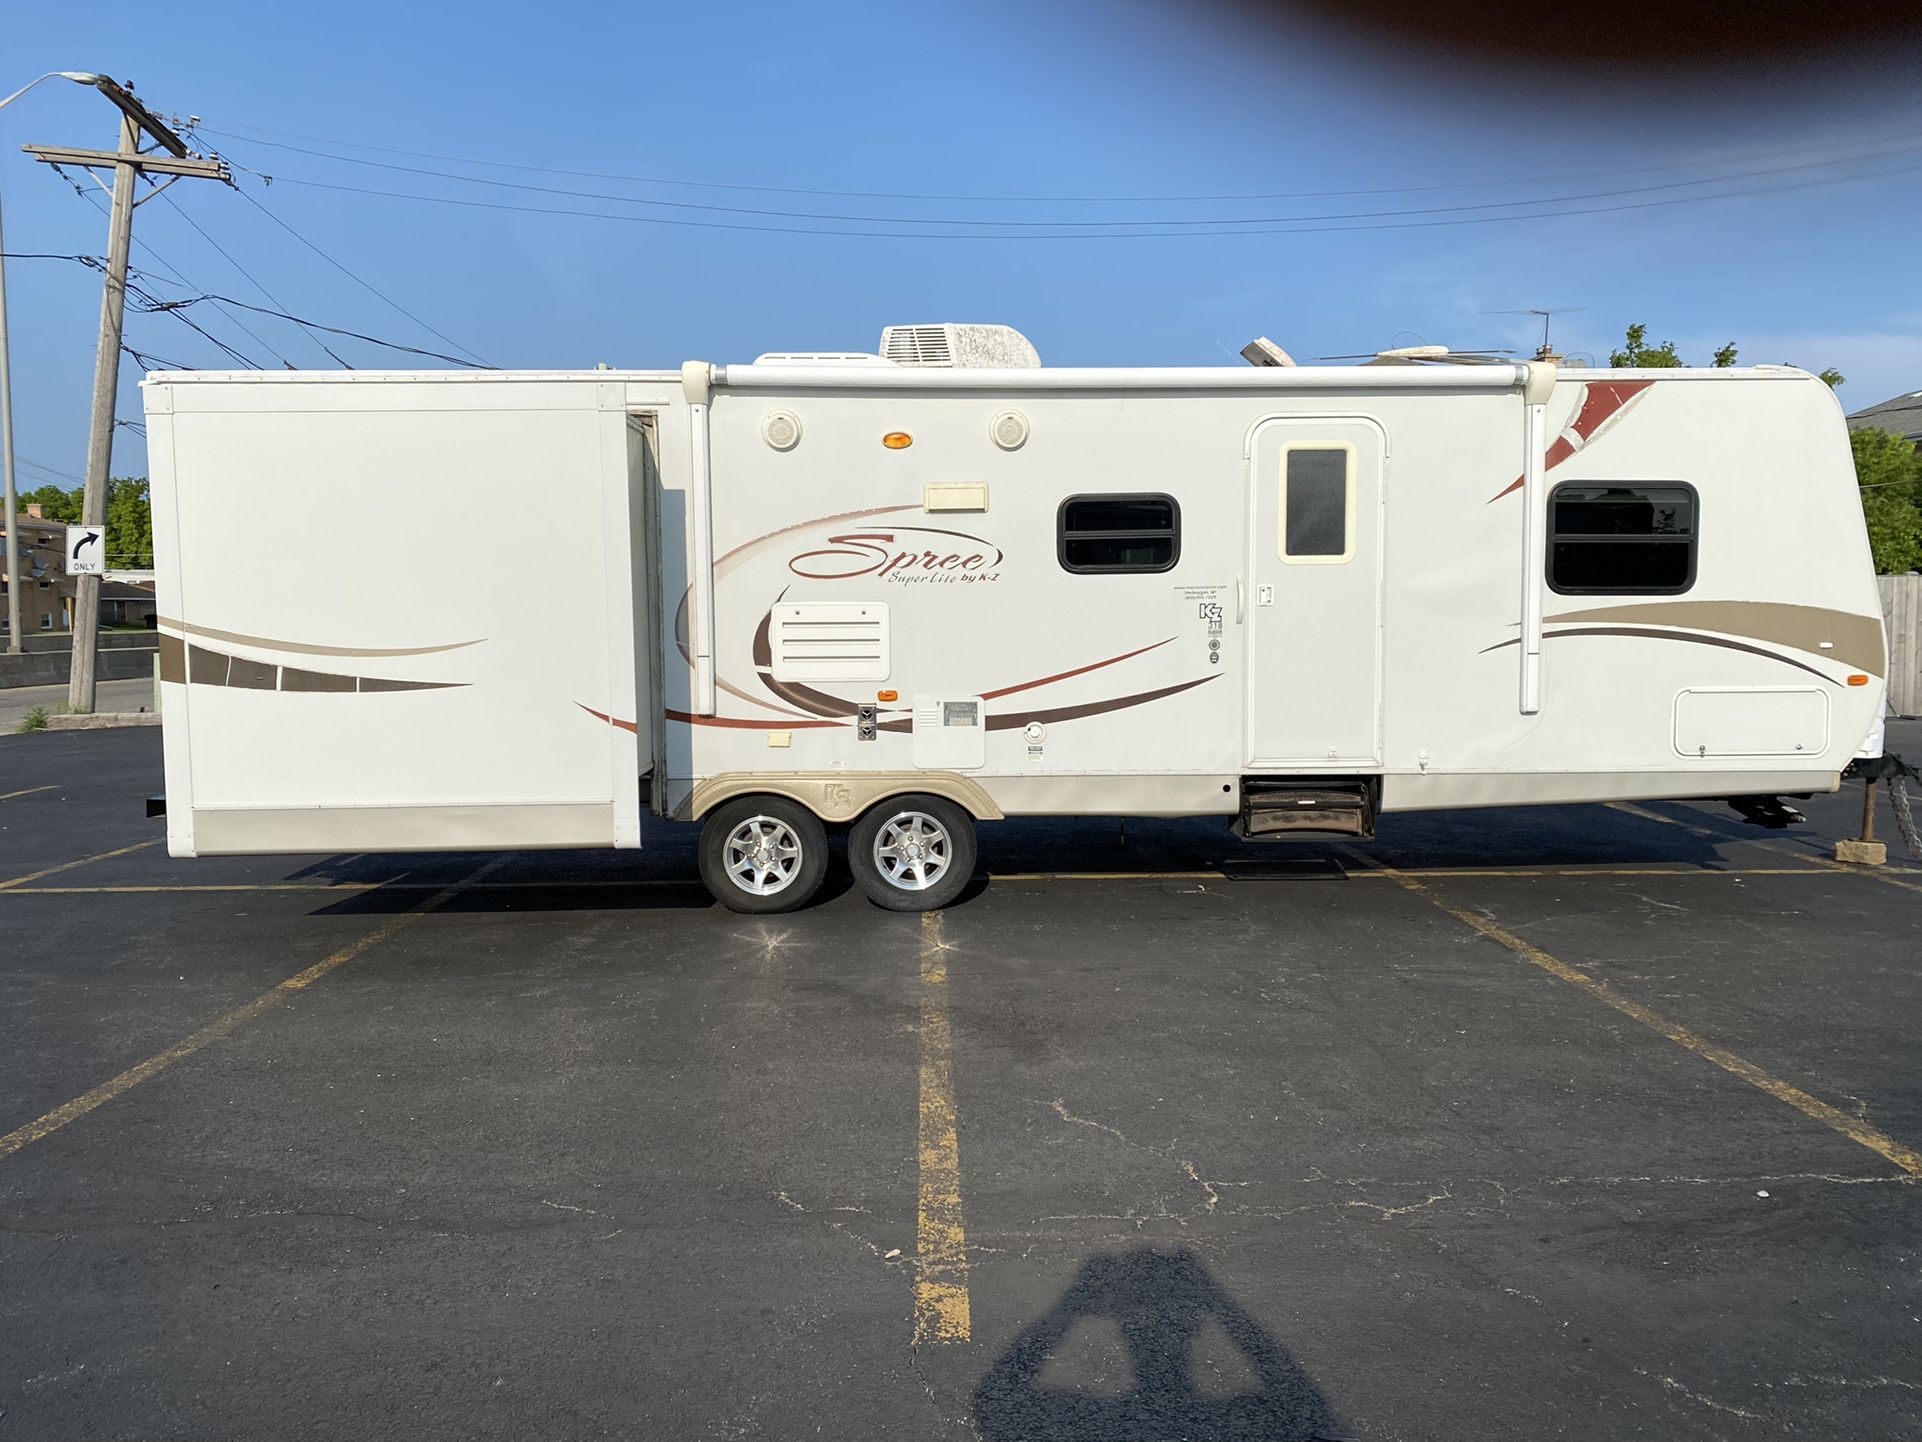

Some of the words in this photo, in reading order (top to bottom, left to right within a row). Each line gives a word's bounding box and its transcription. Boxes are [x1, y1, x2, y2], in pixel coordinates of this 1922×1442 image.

[789, 534, 987, 579] Spree
[73, 562, 95, 571] ONLY
[961, 574, 976, 583] by
[978, 573, 1000, 582] K-Z
